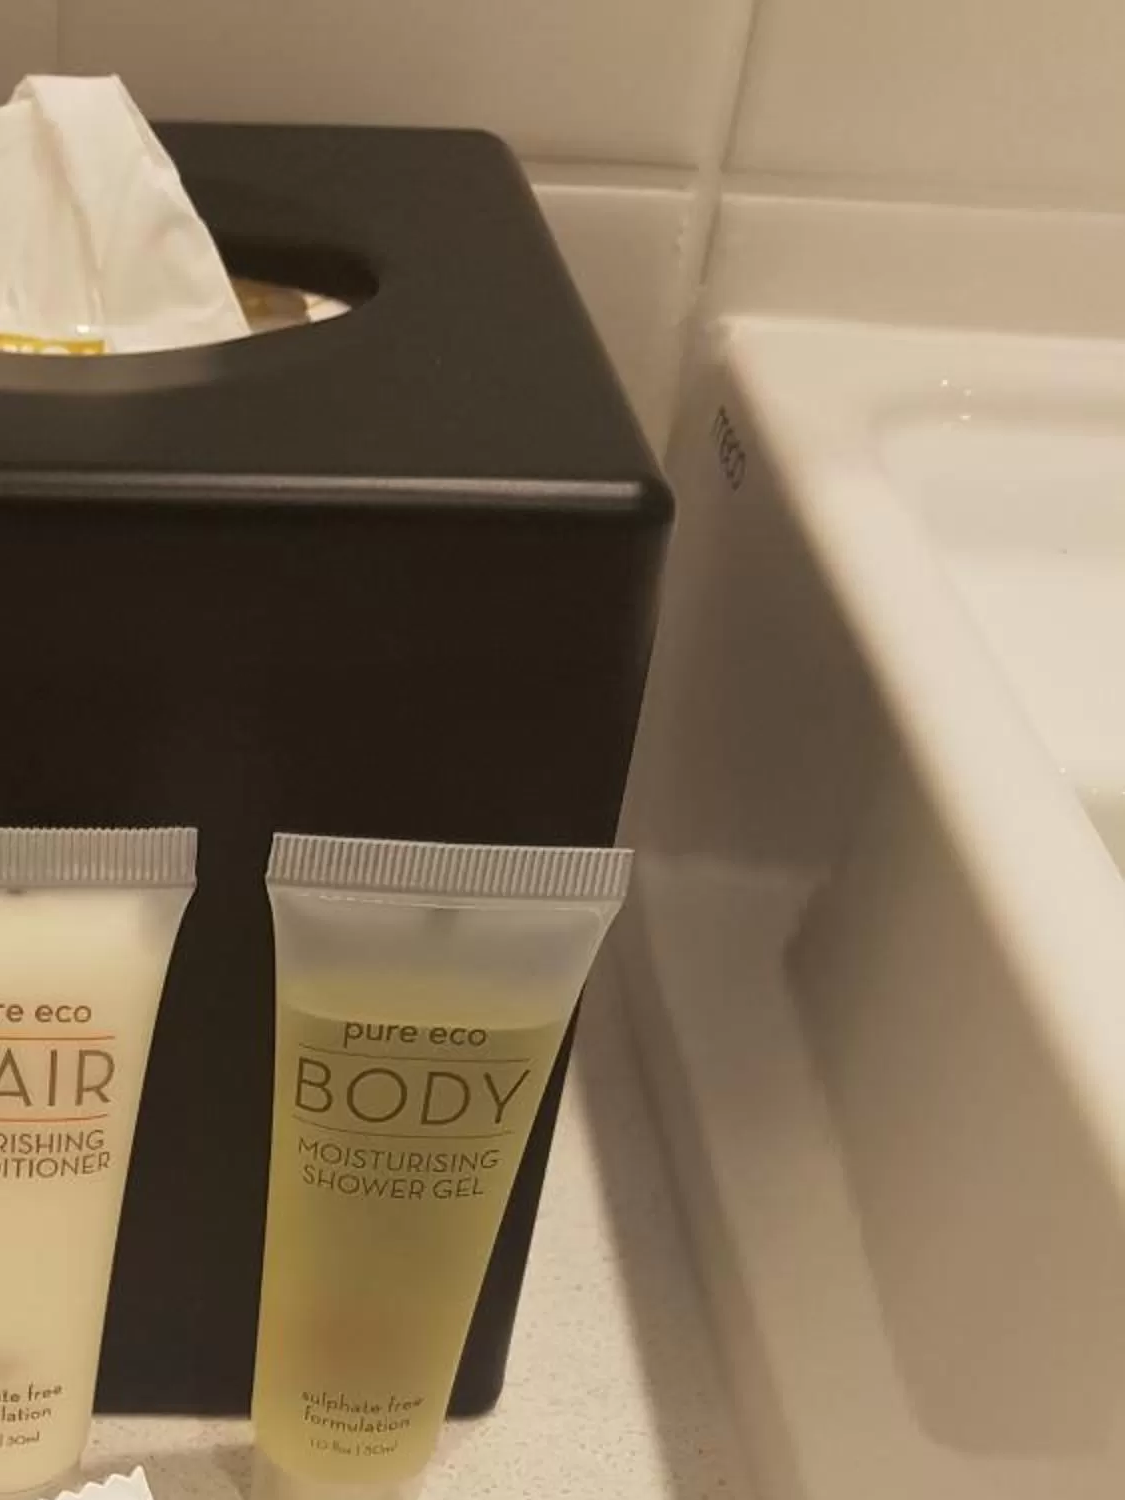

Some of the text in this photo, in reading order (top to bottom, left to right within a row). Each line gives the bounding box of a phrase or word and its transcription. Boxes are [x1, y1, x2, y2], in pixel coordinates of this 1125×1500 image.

[34, 1003, 93, 1024] eco
[342, 1021, 488, 1049] pure eco
[294, 1056, 532, 1126] BODY
[298, 1136, 501, 1174] MOISTURISING
[301, 1164, 485, 1200] SHOWER GEL
[28, 1381, 63, 1402] free
[301, 1391, 425, 1415] sulphate free
[304, 1404, 412, 1434] formulation
